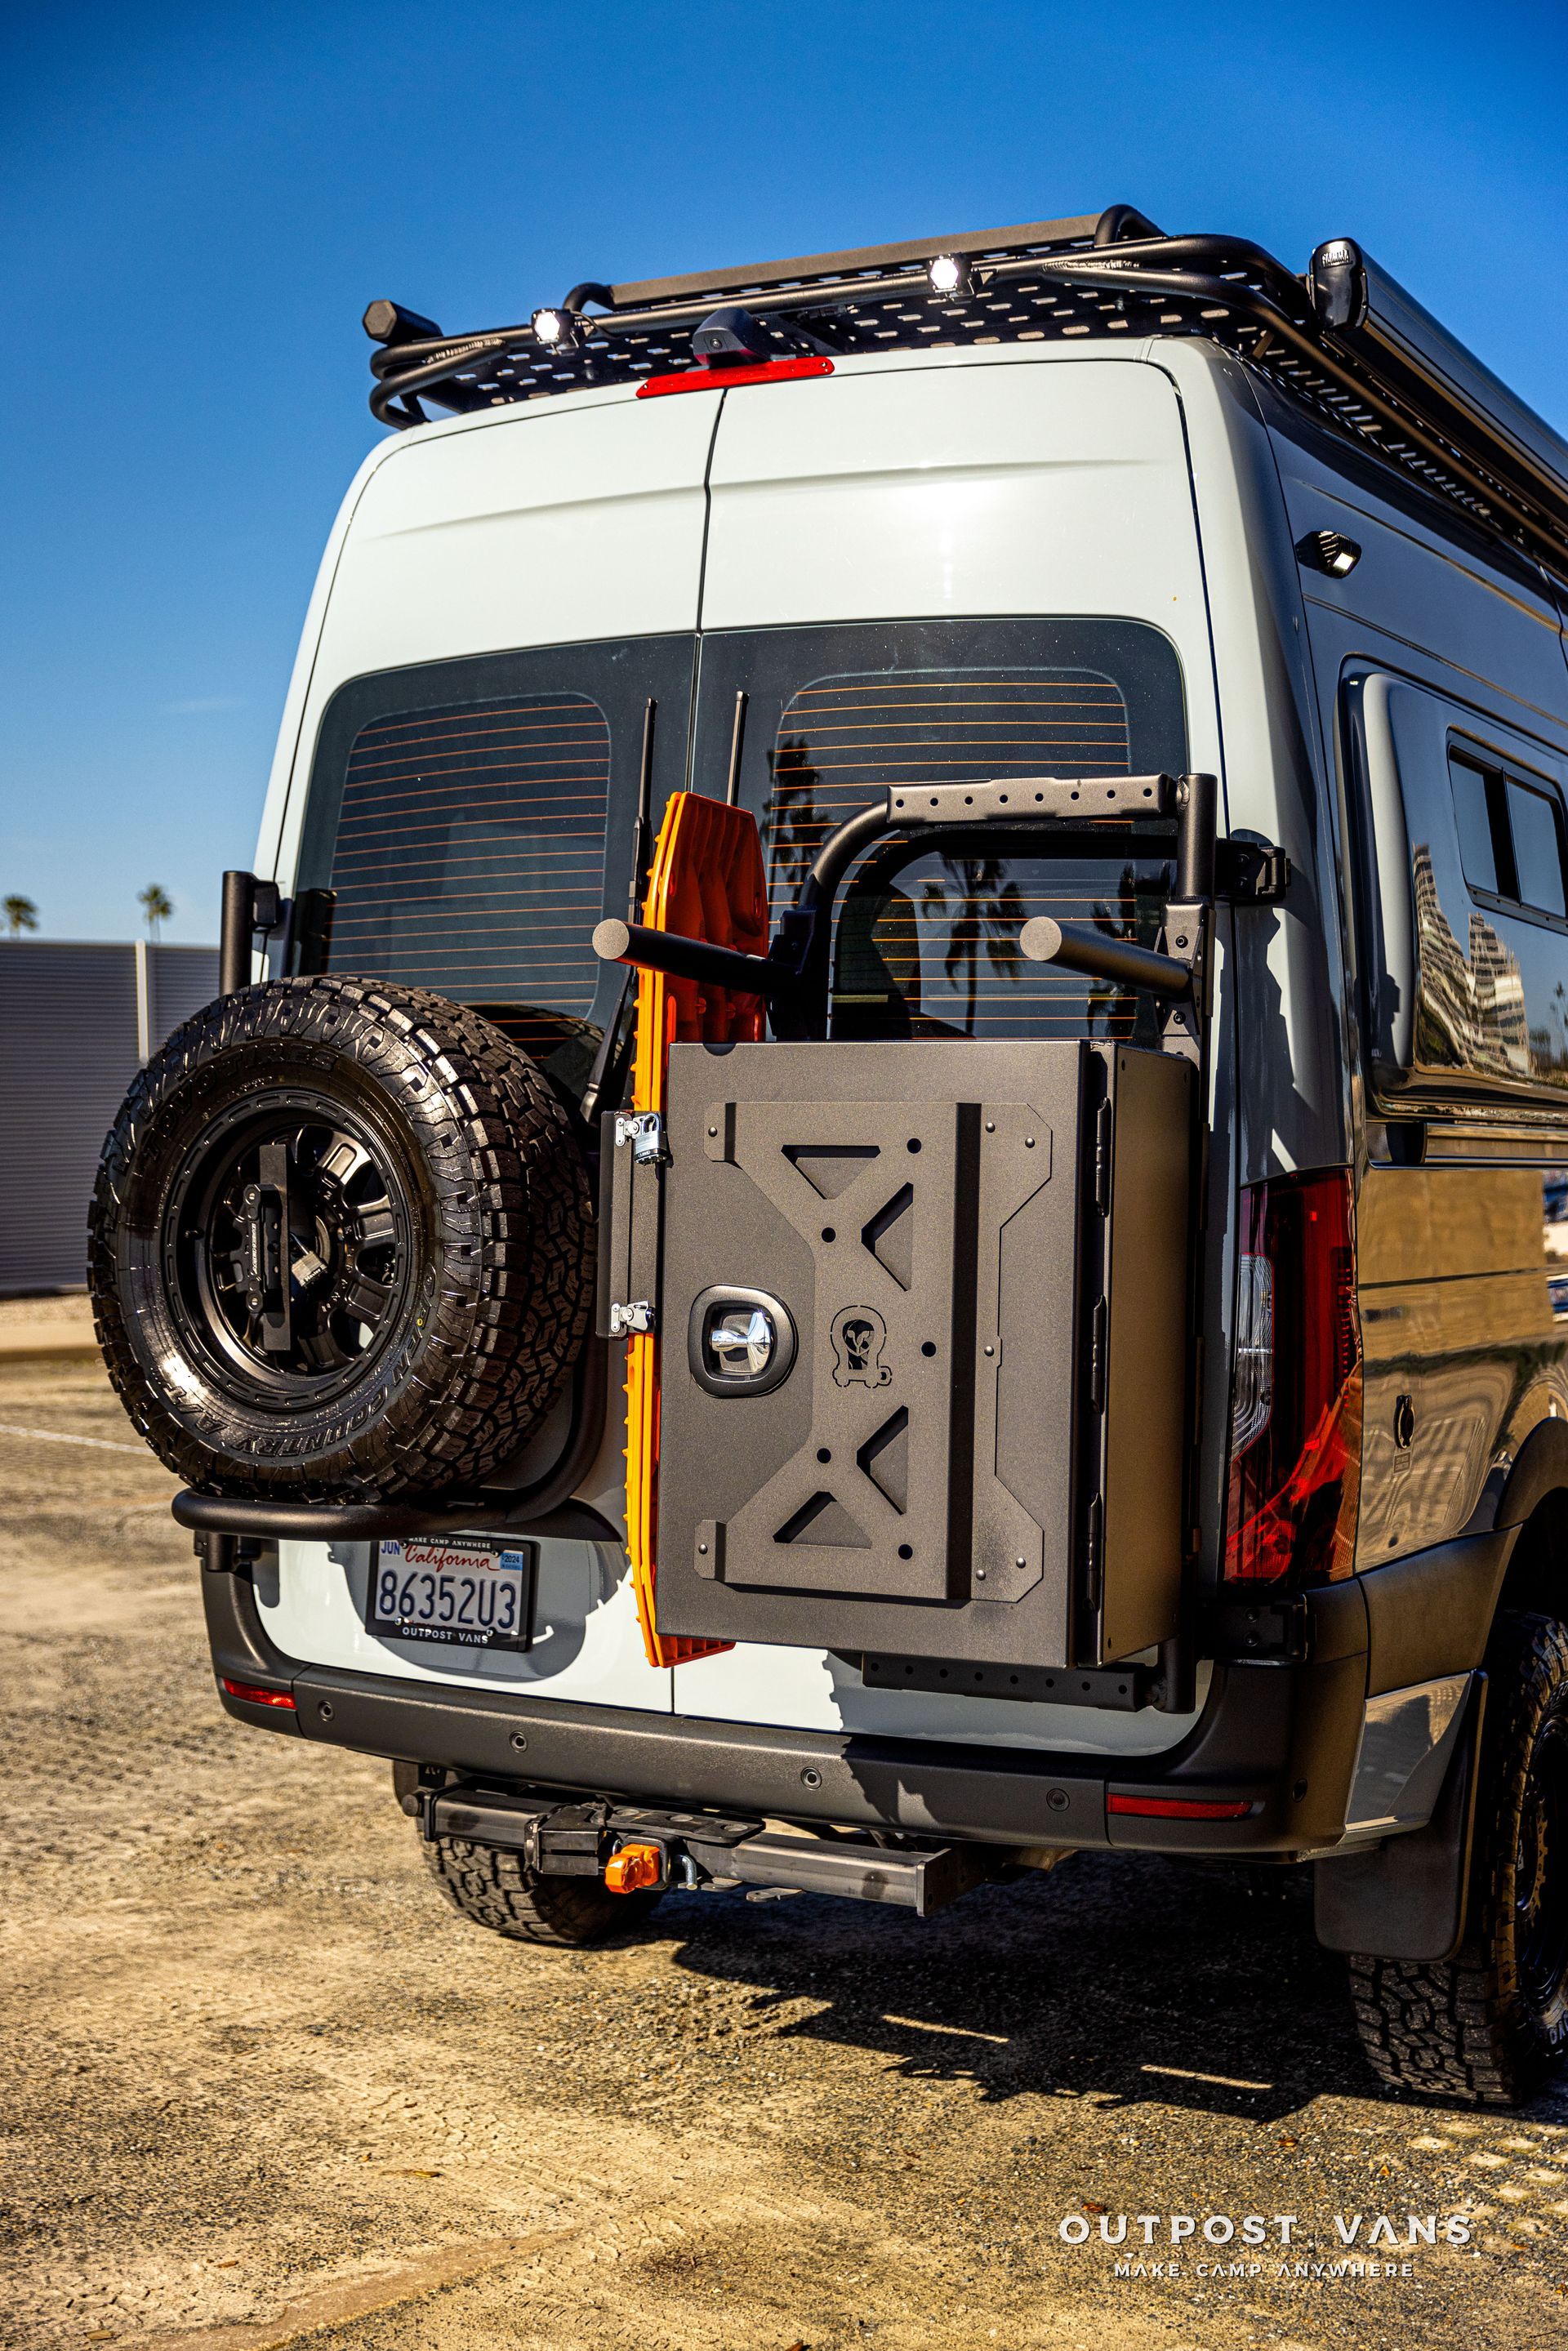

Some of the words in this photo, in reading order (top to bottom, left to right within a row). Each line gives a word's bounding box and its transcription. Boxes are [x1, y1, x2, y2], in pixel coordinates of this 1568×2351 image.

[141, 1064, 217, 1164] TOYO
[219, 1042, 340, 1076] TIRES
[232, 1385, 389, 1457] COUNTRY
[381, 1541, 400, 1556] JUN
[452, 1540, 491, 1549] ANYWHERE
[405, 1544, 500, 1573] California
[504, 1554, 520, 1563] 2024
[379, 1569, 516, 1630] 86352U3
[402, 1627, 452, 1640] OUTPOST
[458, 1632, 488, 1644] VANS
